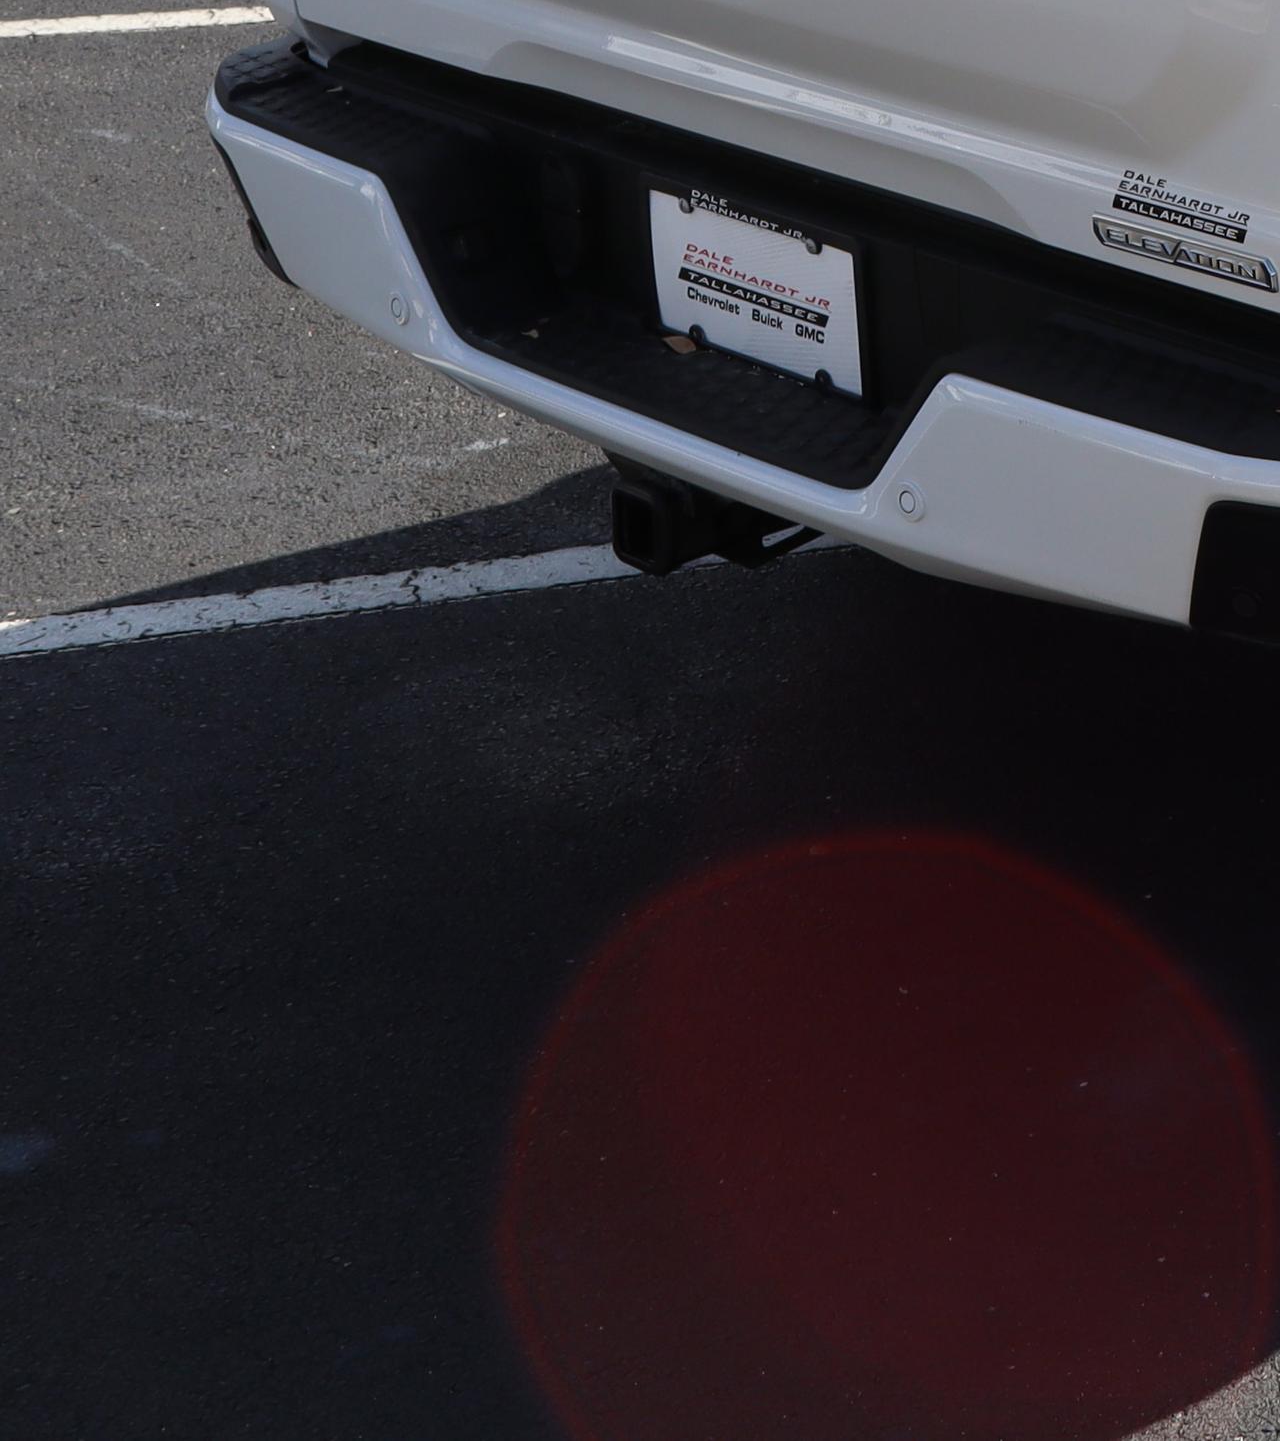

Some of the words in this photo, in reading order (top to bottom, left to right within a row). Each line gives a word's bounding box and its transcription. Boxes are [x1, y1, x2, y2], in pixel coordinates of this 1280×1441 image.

[691, 189, 728, 207] DALE
[1124, 169, 1167, 188] DALE
[690, 198, 779, 231] EARNHARDT
[1118, 180, 1224, 214] EARNHARDT
[1227, 210, 1250, 225] JR
[1119, 198, 1239, 240] TALLAHASSEE
[686, 243, 734, 265] DALE
[1106, 229, 1260, 280] ELEVATION
[683, 254, 799, 297] EARNHARDT
[805, 295, 831, 309] JR
[688, 272, 819, 322] TALLAHASSEE
[687, 286, 740, 315] Chevrolet
[752, 309, 783, 330] Buick
[795, 323, 825, 344] GMC
